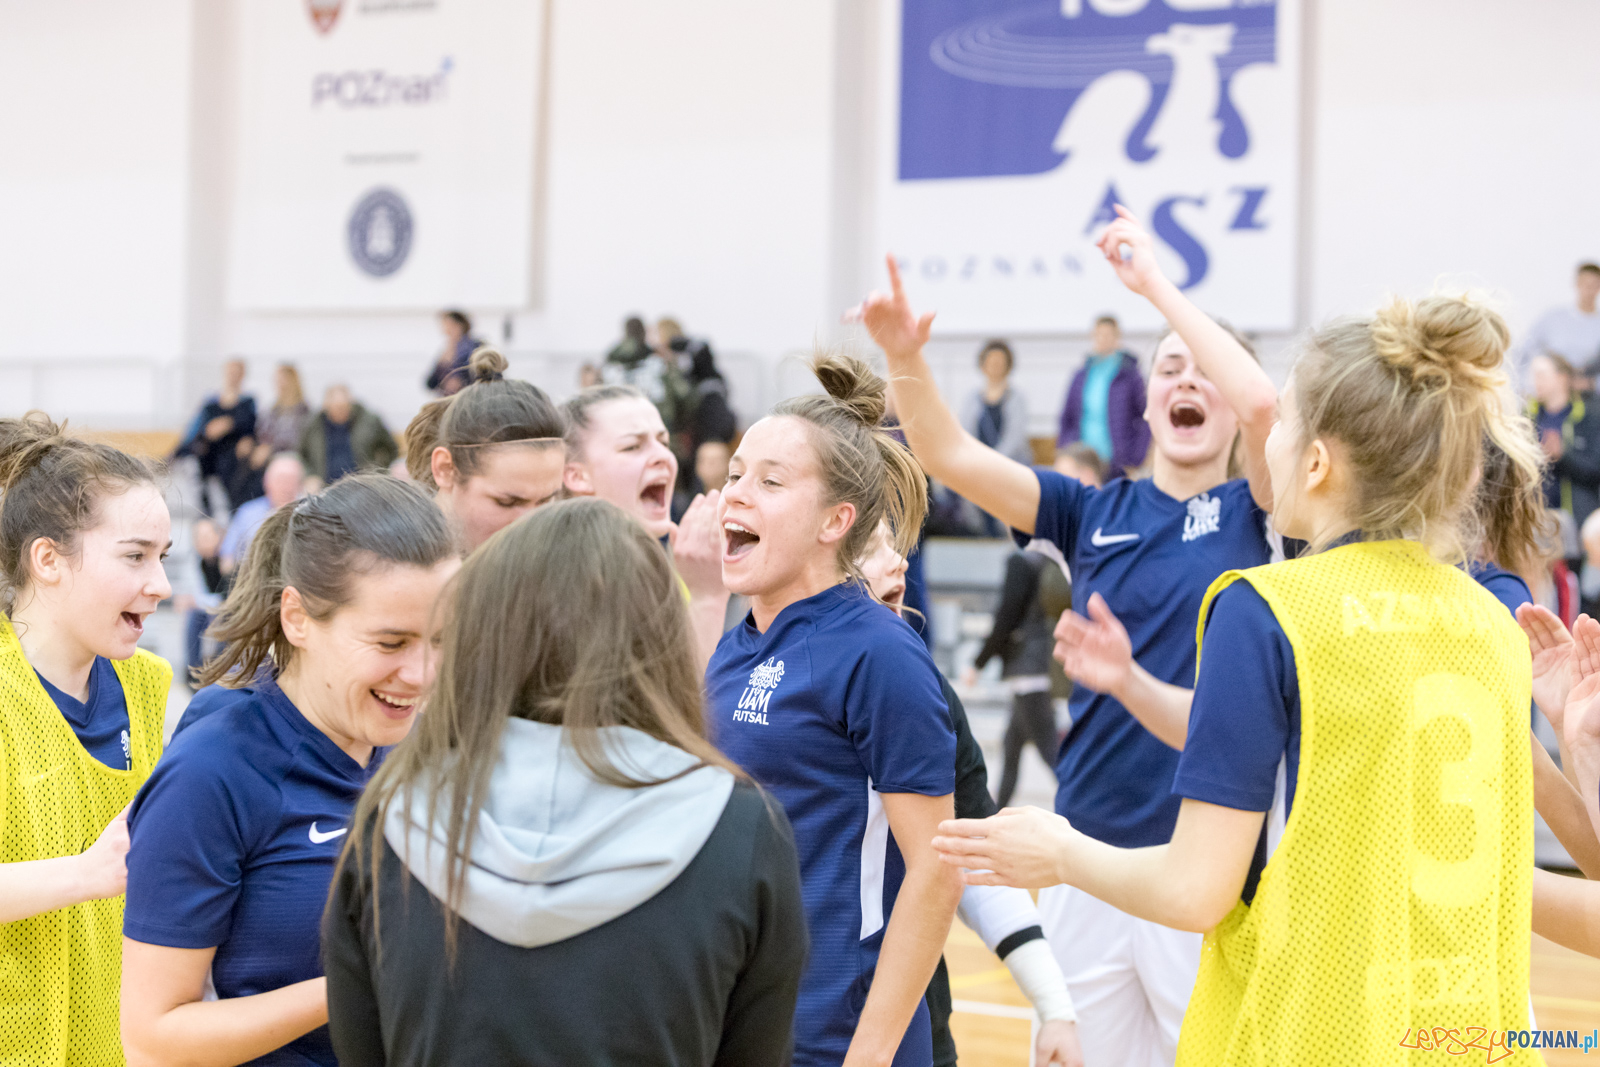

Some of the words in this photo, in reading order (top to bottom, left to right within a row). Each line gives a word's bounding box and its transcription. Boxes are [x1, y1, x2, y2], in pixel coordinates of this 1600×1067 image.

[737, 687, 773, 713] UAM
[732, 709, 769, 726] FUTSAL
[1411, 671, 1500, 906] 3
